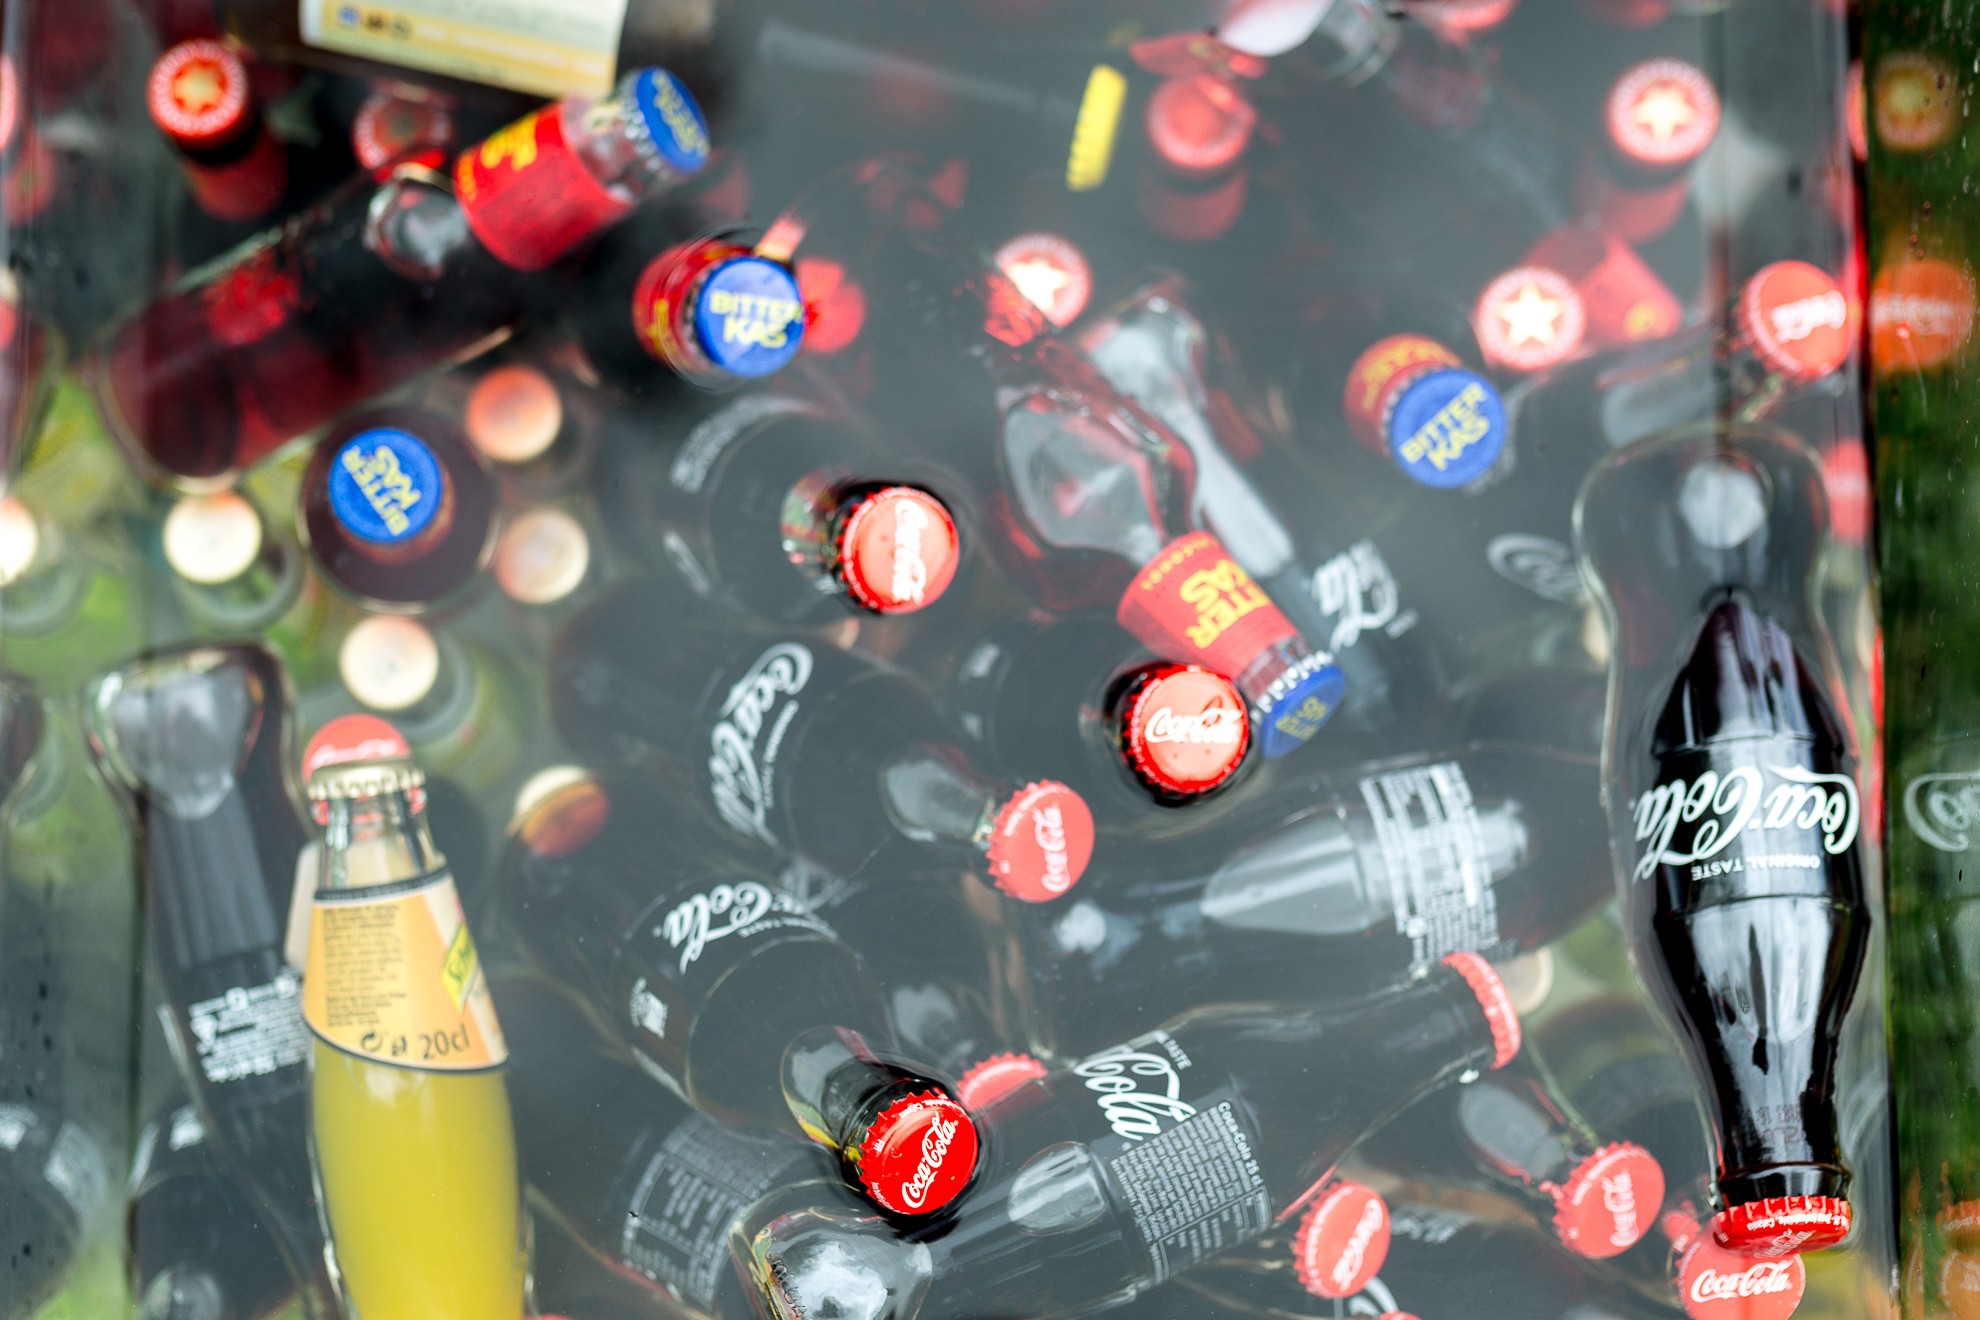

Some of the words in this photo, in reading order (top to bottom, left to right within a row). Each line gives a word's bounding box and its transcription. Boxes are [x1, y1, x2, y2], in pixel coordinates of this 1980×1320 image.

[723, 316, 788, 349] KAS
[1400, 380, 1486, 463] BITTER
[1428, 416, 1490, 470] KAS
[340, 445, 410, 537] BITTER
[374, 445, 423, 516] KAS
[1632, 764, 1861, 884] Coca-Cola
[1690, 857, 1743, 882] TASTE
[1746, 853, 1821, 870] ORIGINAL
[901, 1113, 958, 1209] Coca-Cola
[1216, 1100, 1253, 1160] Coca-Cola
[1244, 1158, 1261, 1176] 25
[1690, 1259, 1795, 1304] Coca-Cola
